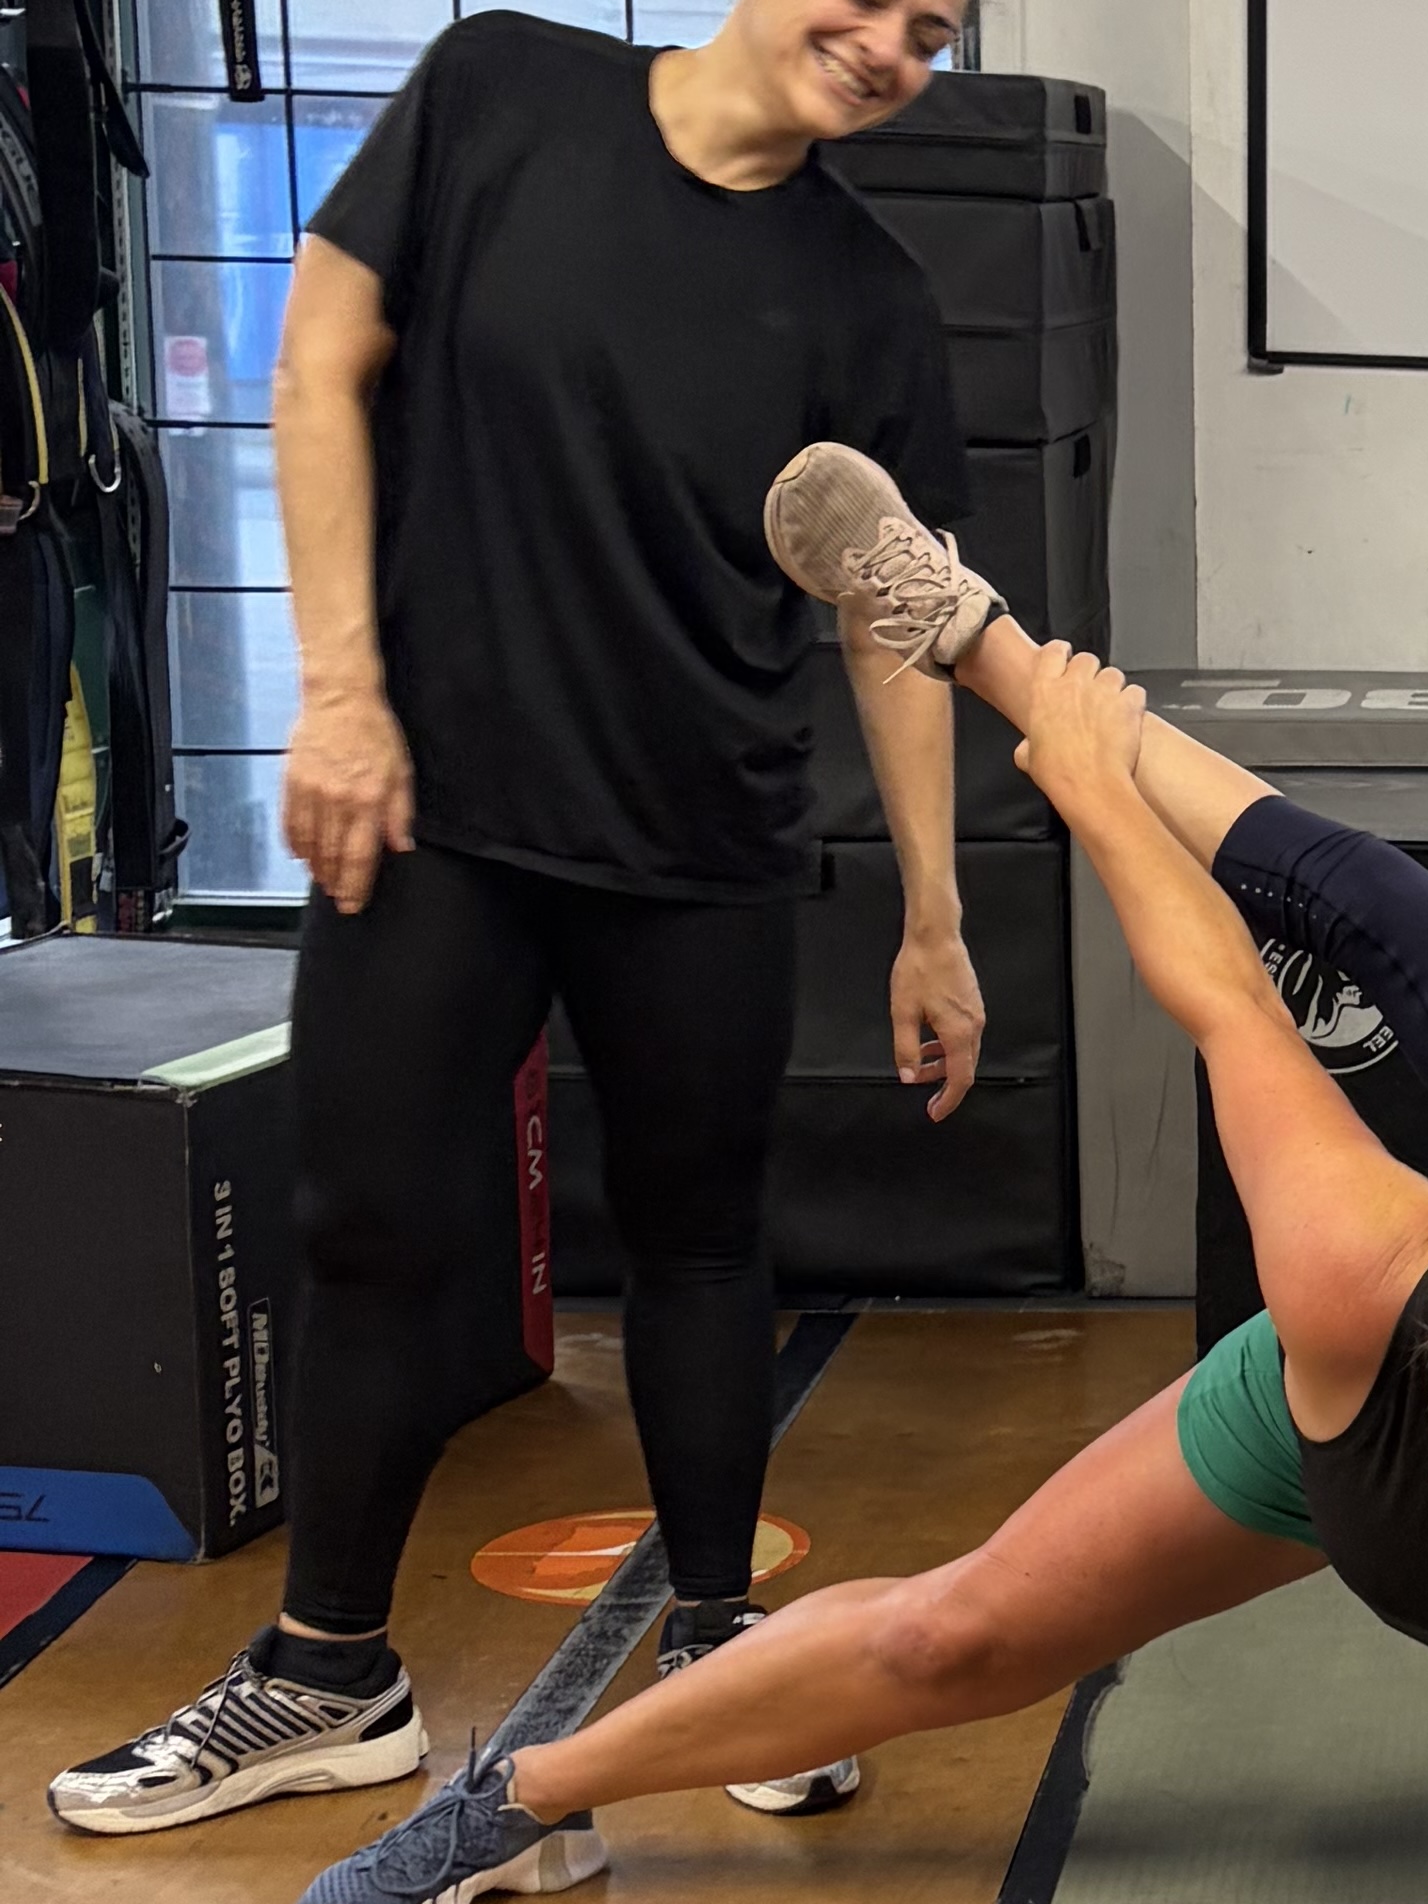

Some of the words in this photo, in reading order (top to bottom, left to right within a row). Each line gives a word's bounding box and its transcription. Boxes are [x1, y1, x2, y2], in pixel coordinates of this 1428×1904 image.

[214, 1204, 234, 1241] IN
[217, 1243, 235, 1263] 1
[218, 1266, 241, 1349] SOFT
[222, 1355, 245, 1445] PLYO
